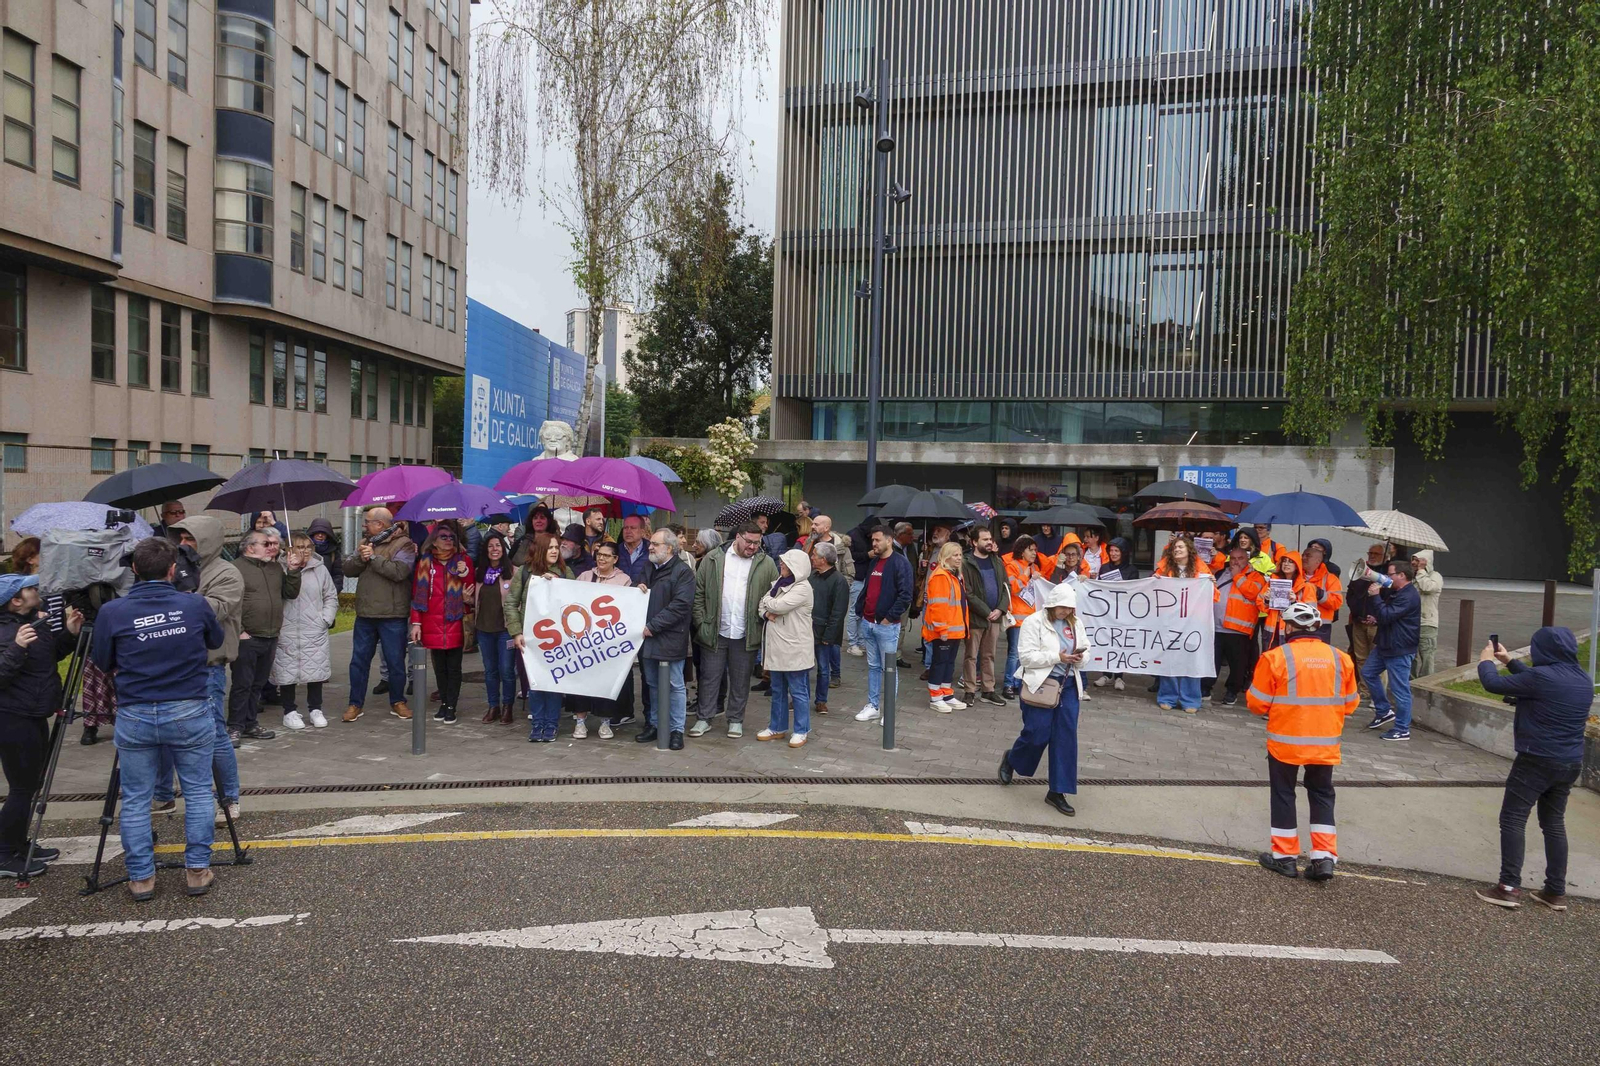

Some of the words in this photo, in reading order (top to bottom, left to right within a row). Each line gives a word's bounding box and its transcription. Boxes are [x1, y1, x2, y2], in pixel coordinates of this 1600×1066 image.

[492, 387, 526, 418] XUNTA
[491, 418, 505, 444] DE
[507, 422, 543, 450] GALICIA
[133, 613, 167, 628] SER
[147, 626, 187, 639] TELEVIGO
[532, 595, 621, 651] SOS
[543, 621, 628, 664] sanidade
[1084, 627, 1201, 652] ECRETAZO
[550, 640, 635, 685] pública
